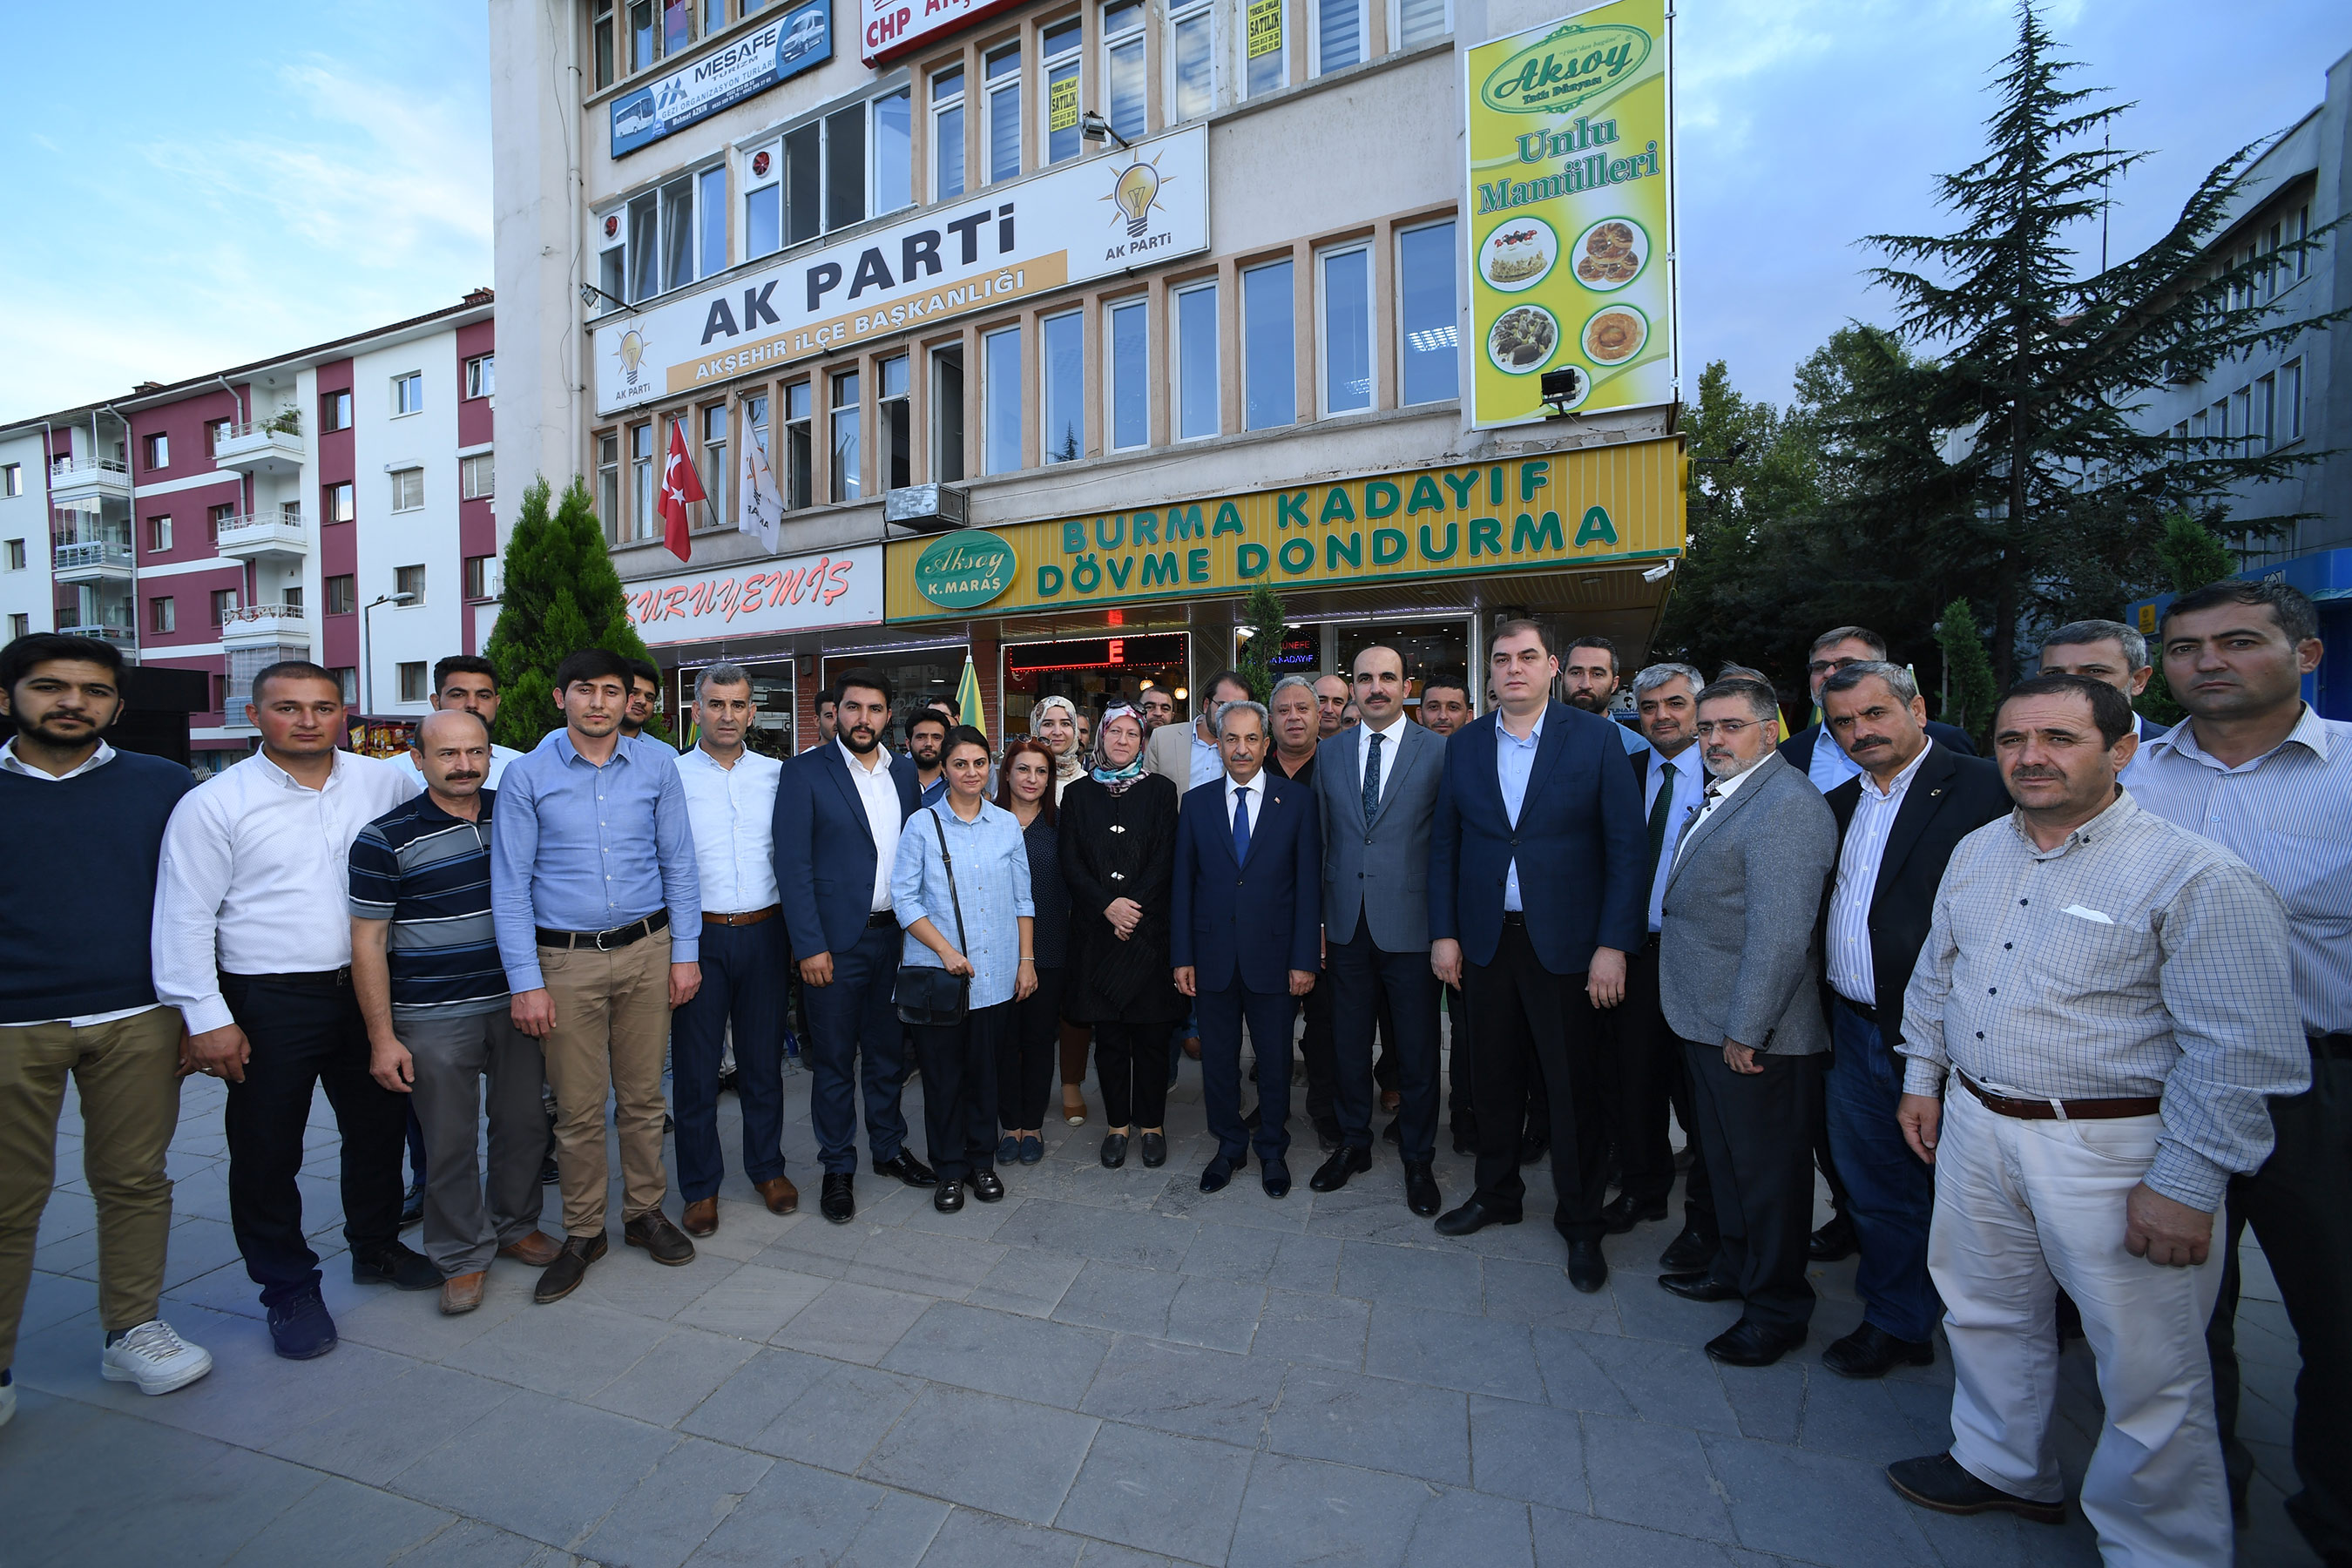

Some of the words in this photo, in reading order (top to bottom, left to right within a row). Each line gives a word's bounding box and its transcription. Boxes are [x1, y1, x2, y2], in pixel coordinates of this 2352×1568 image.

[866, 7, 911, 48] CHP
[1250, 10, 1280, 37] SATILIK
[695, 28, 776, 83] MESAFE
[712, 55, 759, 81] TURİZM
[743, 58, 775, 80] TURLARI
[1494, 42, 1633, 98] Aksoy
[1052, 91, 1076, 112] SATILIK
[1523, 87, 1549, 105] Tatlı
[1552, 77, 1602, 98] Dünyası
[1515, 116, 1619, 164] Unlu
[1477, 140, 1659, 215] Mamülleri
[1105, 245, 1125, 261] AK
[700, 279, 781, 346] AK
[855, 269, 1024, 335] BAŞKANLIĞI
[616, 390, 626, 401] AK
[1063, 501, 1245, 554] BURMA
[1277, 461, 1551, 530] KADAYIF
[925, 546, 1004, 578] Aksoy
[1037, 547, 1210, 597] DÖVME
[1237, 505, 1619, 578] DONDURMA
[928, 577, 1001, 595] K.MARAŞ
[1109, 640, 1123, 663] E
[1278, 655, 1313, 664] KADAYIF
